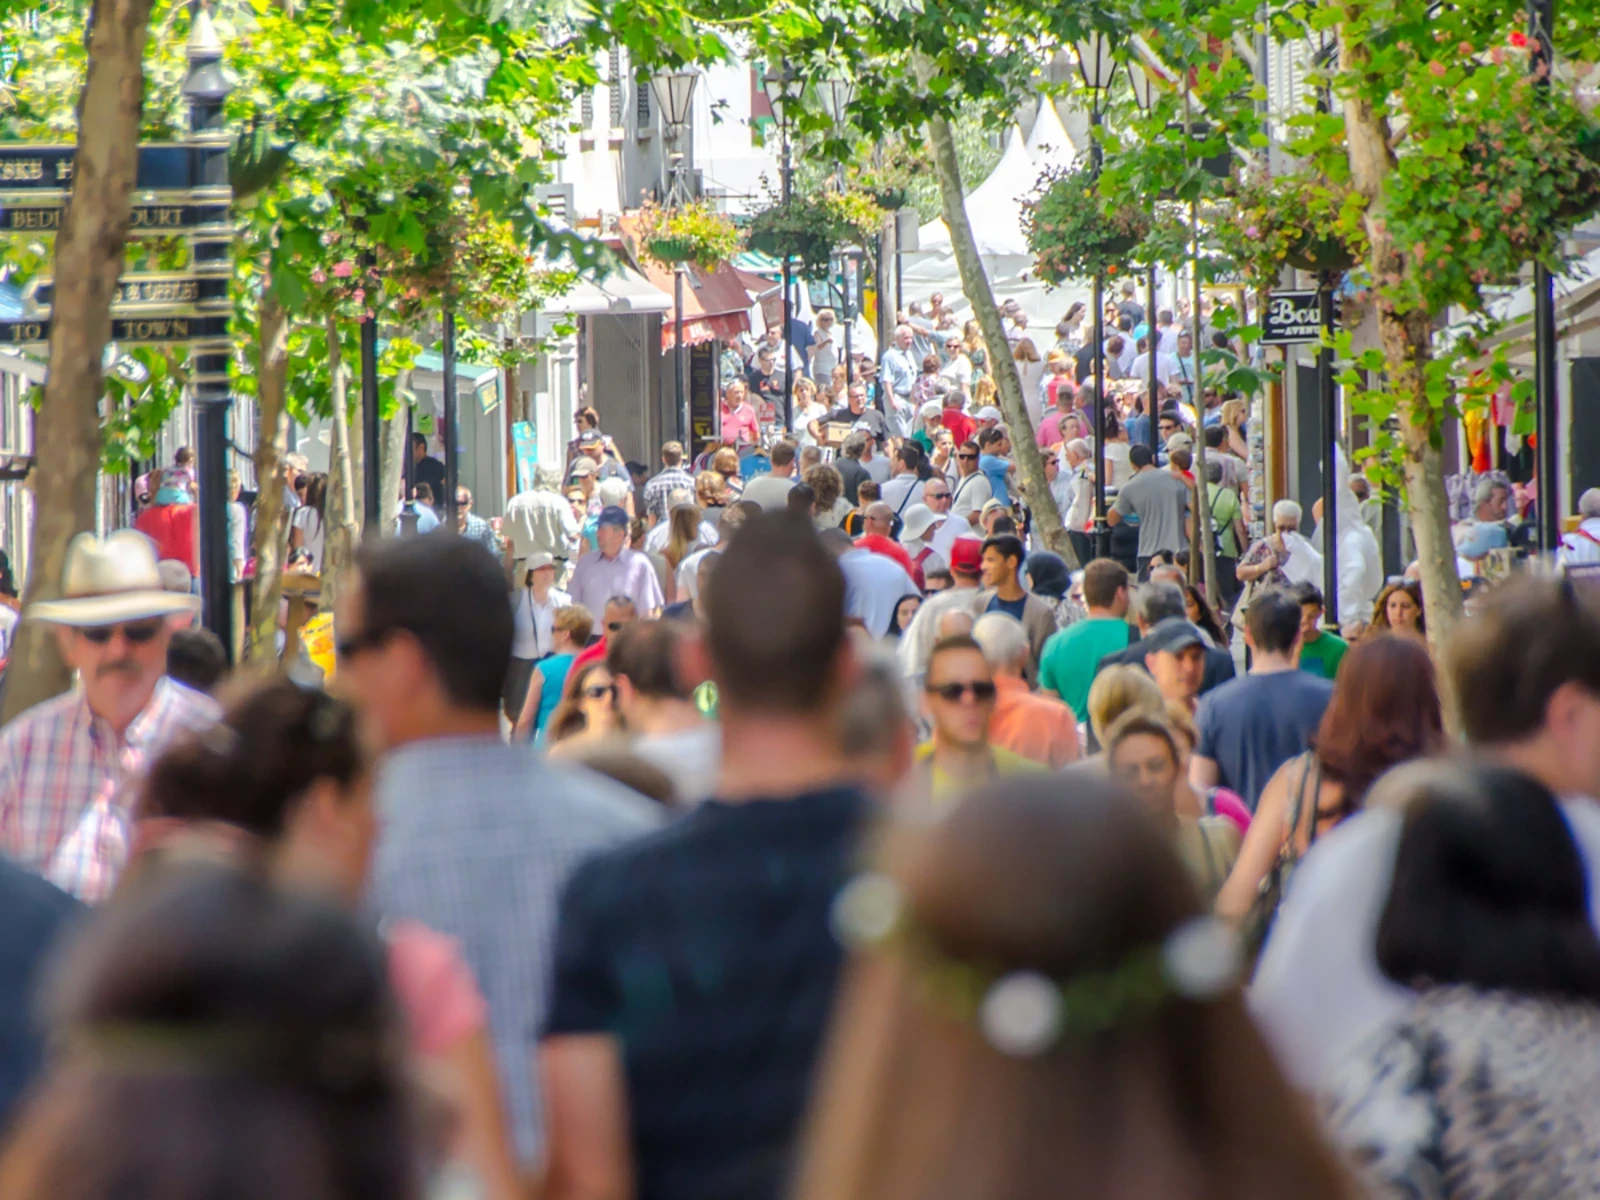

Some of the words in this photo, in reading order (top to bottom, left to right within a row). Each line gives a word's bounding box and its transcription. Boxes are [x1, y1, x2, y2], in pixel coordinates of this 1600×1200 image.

[0, 159, 43, 180] SKE
[11, 210, 60, 229] BEDI
[127, 208, 185, 226] OURT
[1215, 271, 1242, 284] ISA
[1269, 298, 1322, 325] Bou
[10, 323, 41, 341] TO
[122, 319, 189, 339] TOWN
[1285, 325, 1321, 336] AVENU
